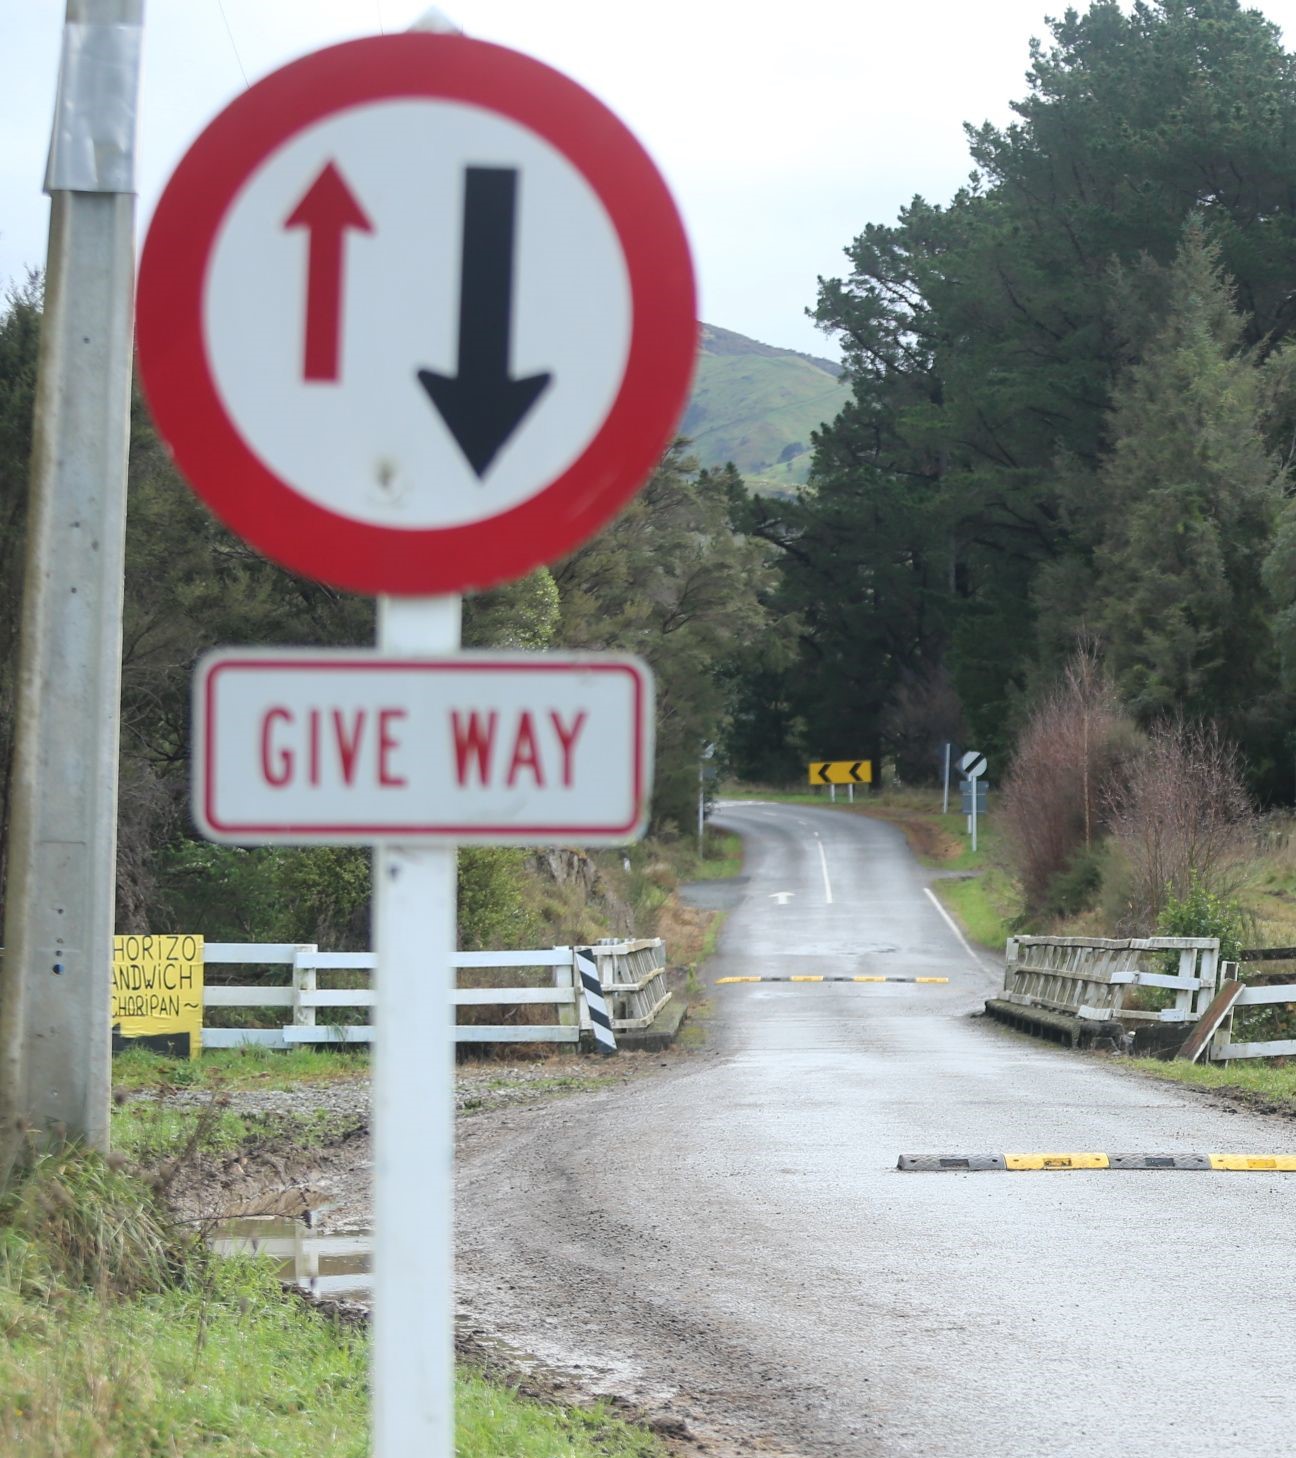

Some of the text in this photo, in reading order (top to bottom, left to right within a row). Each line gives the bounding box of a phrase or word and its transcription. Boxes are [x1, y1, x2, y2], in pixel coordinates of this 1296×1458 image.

[261, 706, 587, 789] GIVE WAY
[113, 935, 196, 961] HORiZO
[112, 963, 193, 990] ANDWiCH
